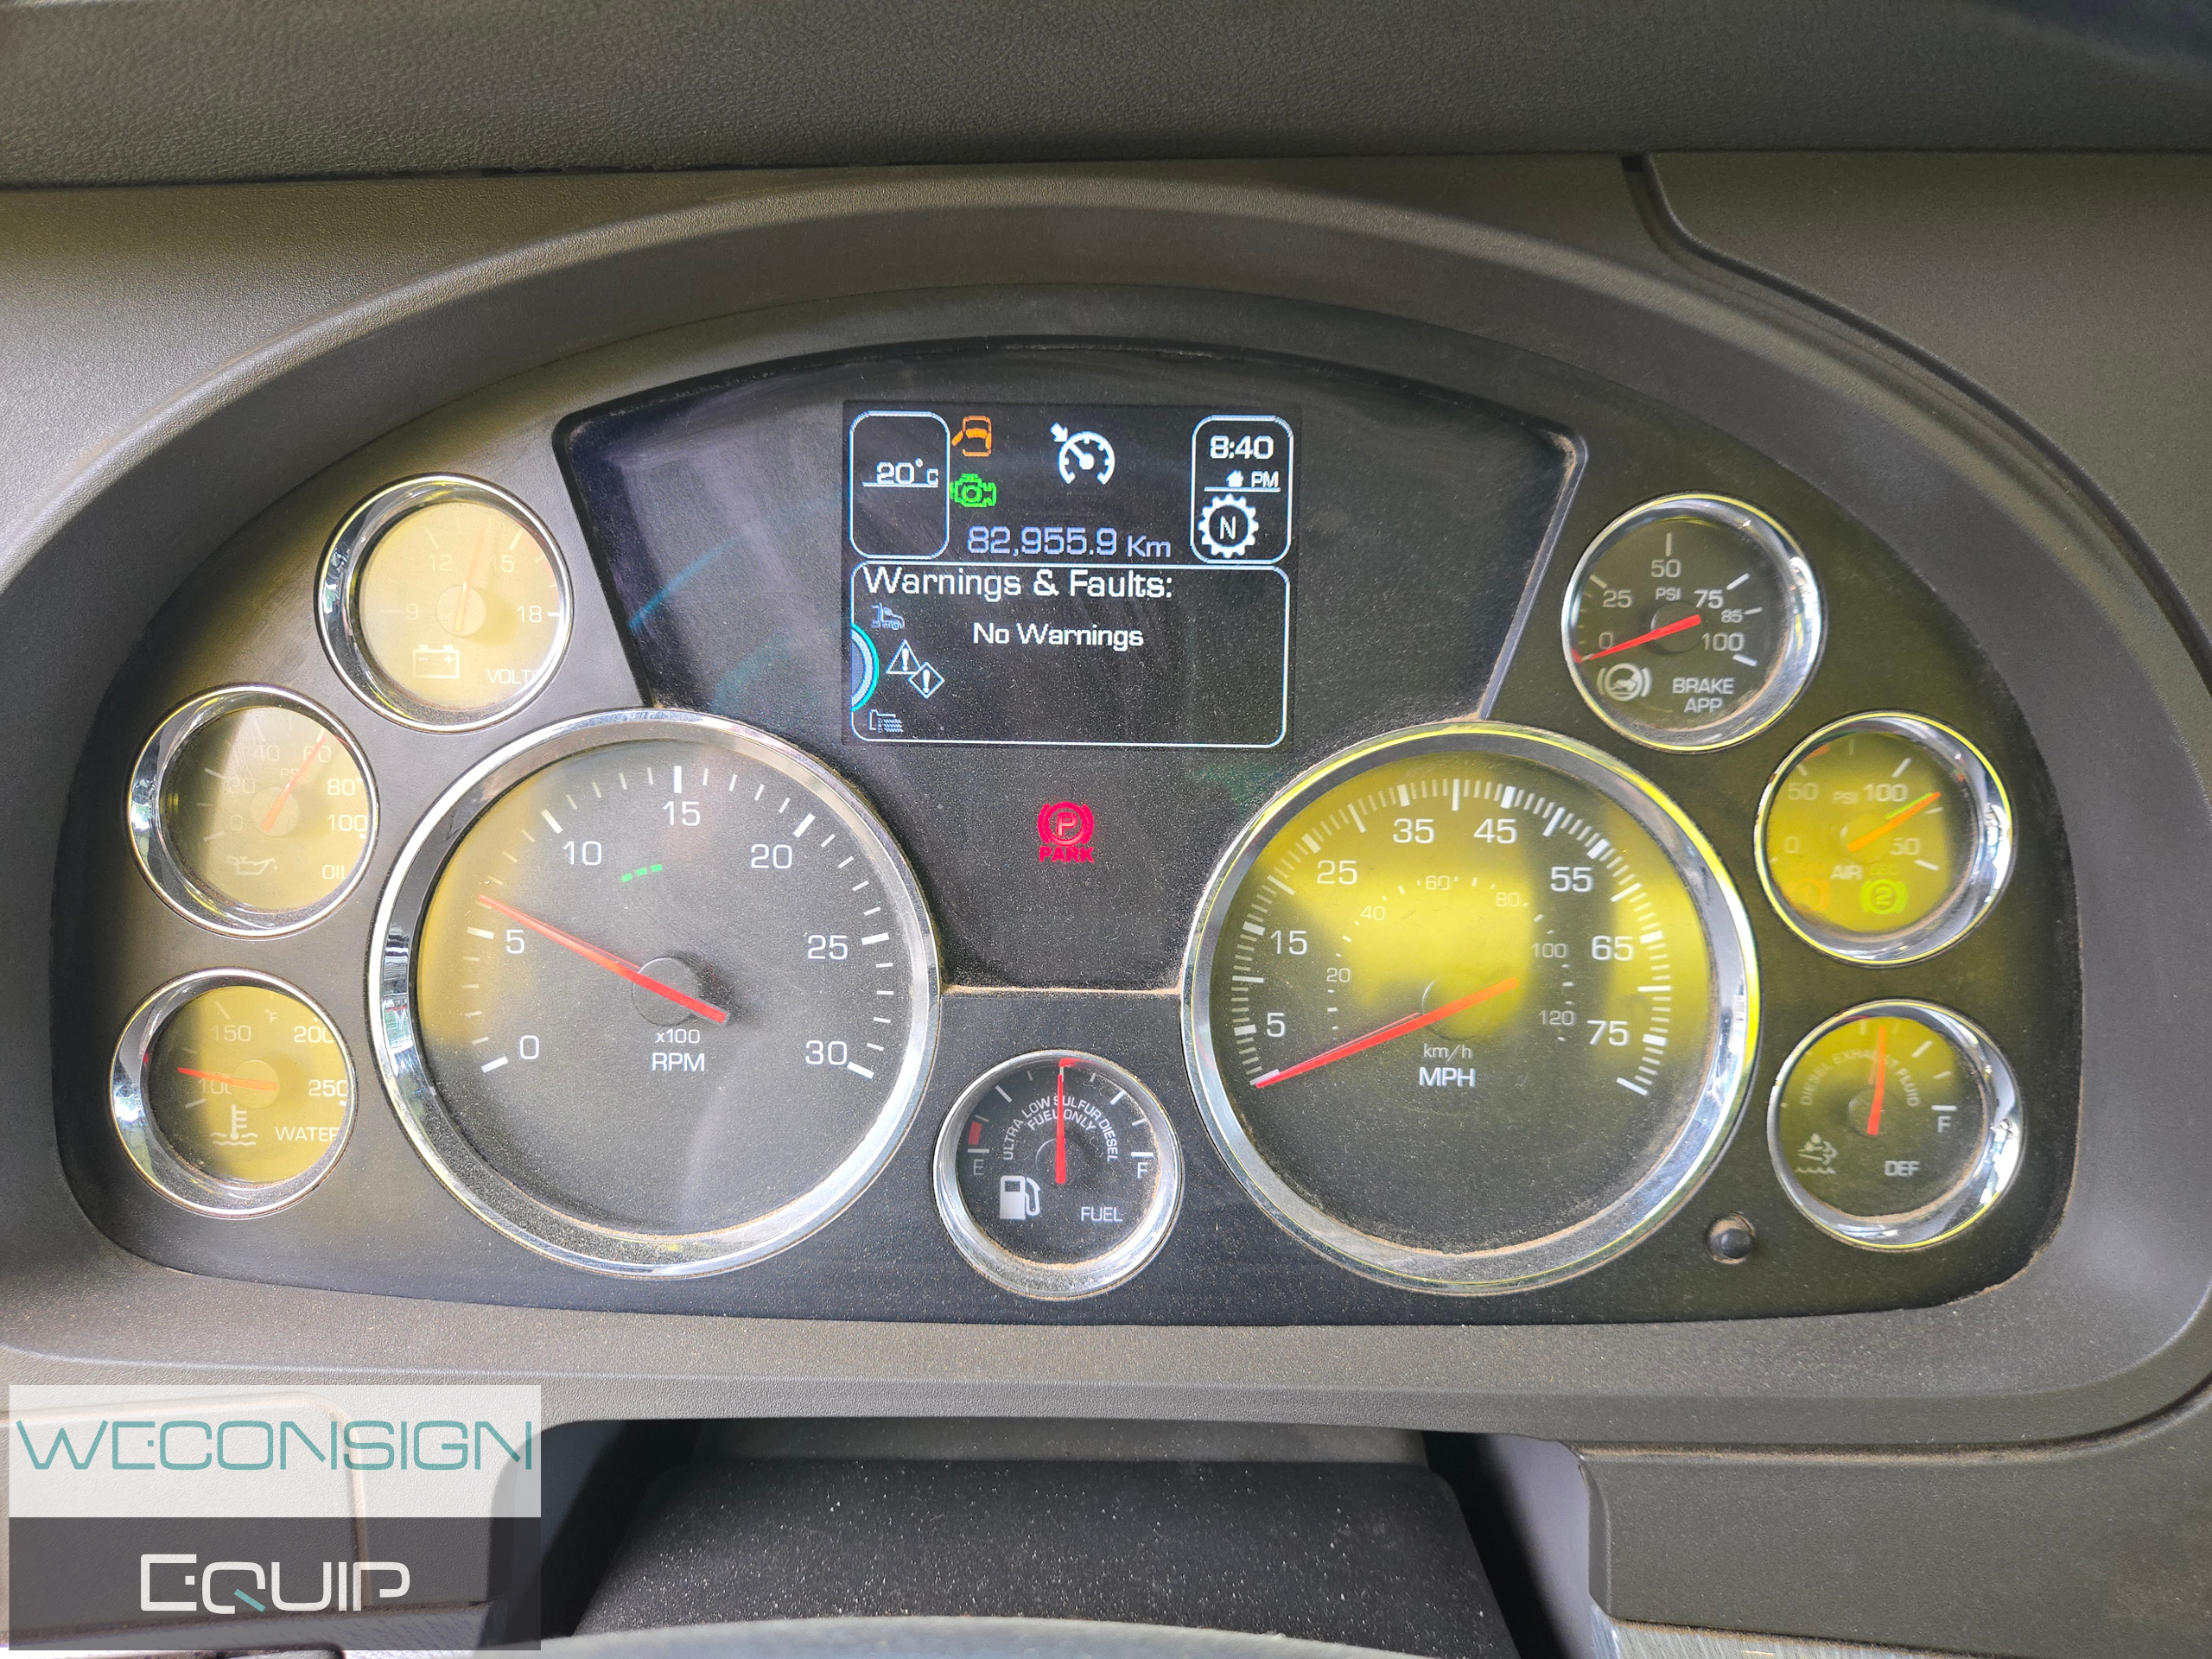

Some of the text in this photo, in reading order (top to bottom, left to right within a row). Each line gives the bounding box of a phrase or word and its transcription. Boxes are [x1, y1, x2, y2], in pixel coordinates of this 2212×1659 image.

[1211, 436, 1274, 460] 8:40
[1251, 472, 1279, 488] PM
[1220, 517, 1236, 539] N
[968, 526, 1171, 557] 82,955.9 Km
[428, 554, 452, 572] 12
[1651, 559, 1681, 578] 50
[863, 566, 1172, 601] Warnings & Faults:
[1603, 589, 1632, 608] 25
[1656, 588, 1681, 601] PSI
[1694, 589, 1724, 609] 75
[517, 605, 543, 624] 18
[974, 622, 1144, 651] No Warnings
[1599, 632, 1613, 650] 0
[1701, 632, 1745, 652] 100
[1672, 677, 1735, 695] BRAKE
[1684, 697, 1724, 713] APP
[327, 779, 356, 796] 80
[1788, 783, 1818, 801] 50
[1864, 784, 1908, 802] 100
[328, 814, 368, 832] 100
[663, 801, 701, 827] 15
[1393, 818, 1435, 844] 35
[1473, 818, 1518, 844] 45
[563, 840, 602, 866] 10
[750, 843, 793, 870] 20
[1039, 846, 1095, 863] PARK
[1316, 860, 1357, 886] 25
[1550, 867, 1593, 893] 55
[1425, 875, 1451, 891] 60
[1496, 893, 1521, 908] 80
[1360, 906, 1385, 921] 40
[505, 930, 525, 955] 5
[807, 934, 848, 961] 25
[1269, 930, 1308, 956] 15
[1531, 944, 1567, 958] 100
[1591, 936, 1635, 962] 65
[1326, 968, 1351, 983] 20
[1266, 1012, 1286, 1038] 5
[1538, 1010, 1577, 1027] 120
[211, 1025, 251, 1042] 150
[655, 1029, 701, 1045] x100
[1587, 1020, 1630, 1047] 75
[519, 1035, 540, 1060] 0
[804, 1039, 848, 1066] 30
[1423, 1043, 1473, 1062] km/h
[651, 1052, 705, 1072] RPM
[1419, 1067, 1476, 1088] MPH
[1003, 1118, 1024, 1160] ULTRA
[1021, 1096, 1051, 1119] LOW
[1098, 1118, 1118, 1162] DIESEL
[1027, 1109, 1096, 1131] FUEL ONLY
[1937, 1116, 1952, 1134] F
[973, 1159, 984, 1176] E
[1137, 1161, 1148, 1179] F
[1885, 1160, 1920, 1177] DEF
[1081, 1206, 1123, 1222] FUEL
